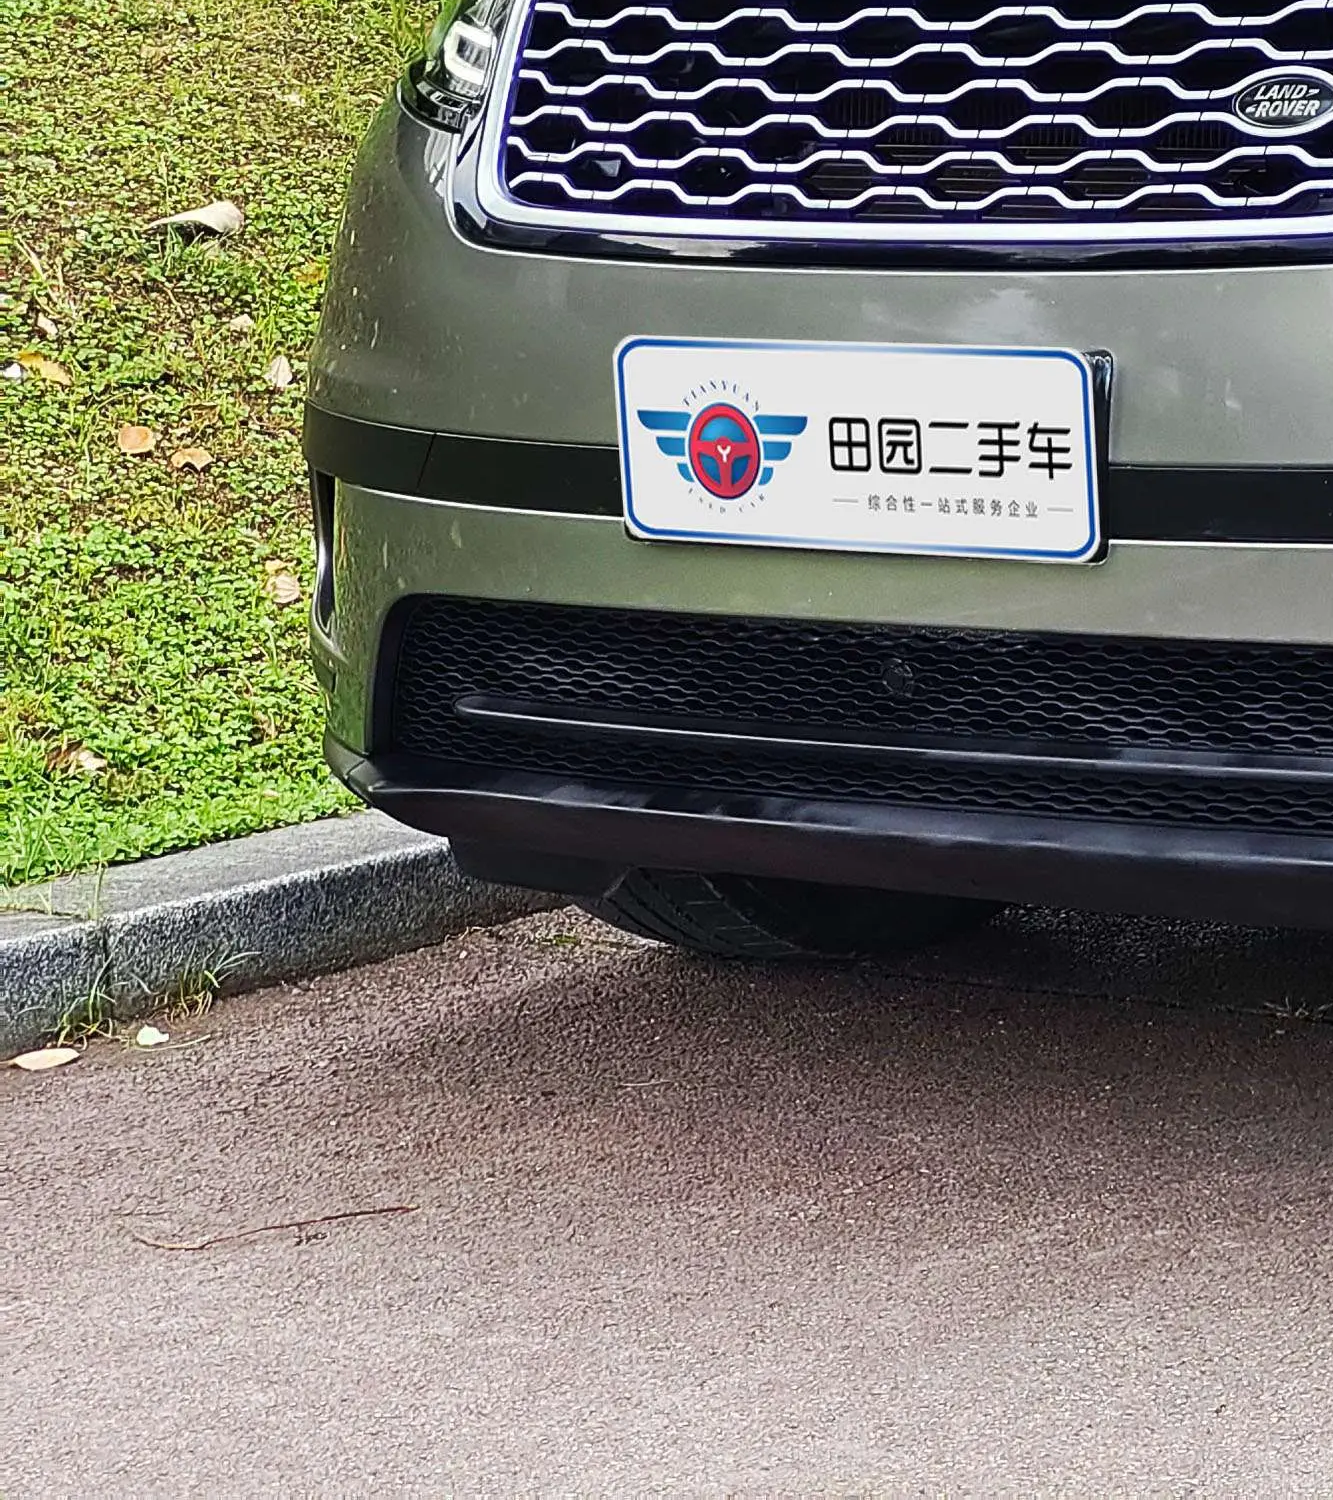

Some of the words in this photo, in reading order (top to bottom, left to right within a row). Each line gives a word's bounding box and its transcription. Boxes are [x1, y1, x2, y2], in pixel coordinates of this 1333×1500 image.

[1254, 84, 1308, 100] LAND
[1254, 99, 1321, 118] ROVER
[828, 416, 1073, 481] 田园二手车
[867, 494, 1039, 519] 综合性一站式服务企业
